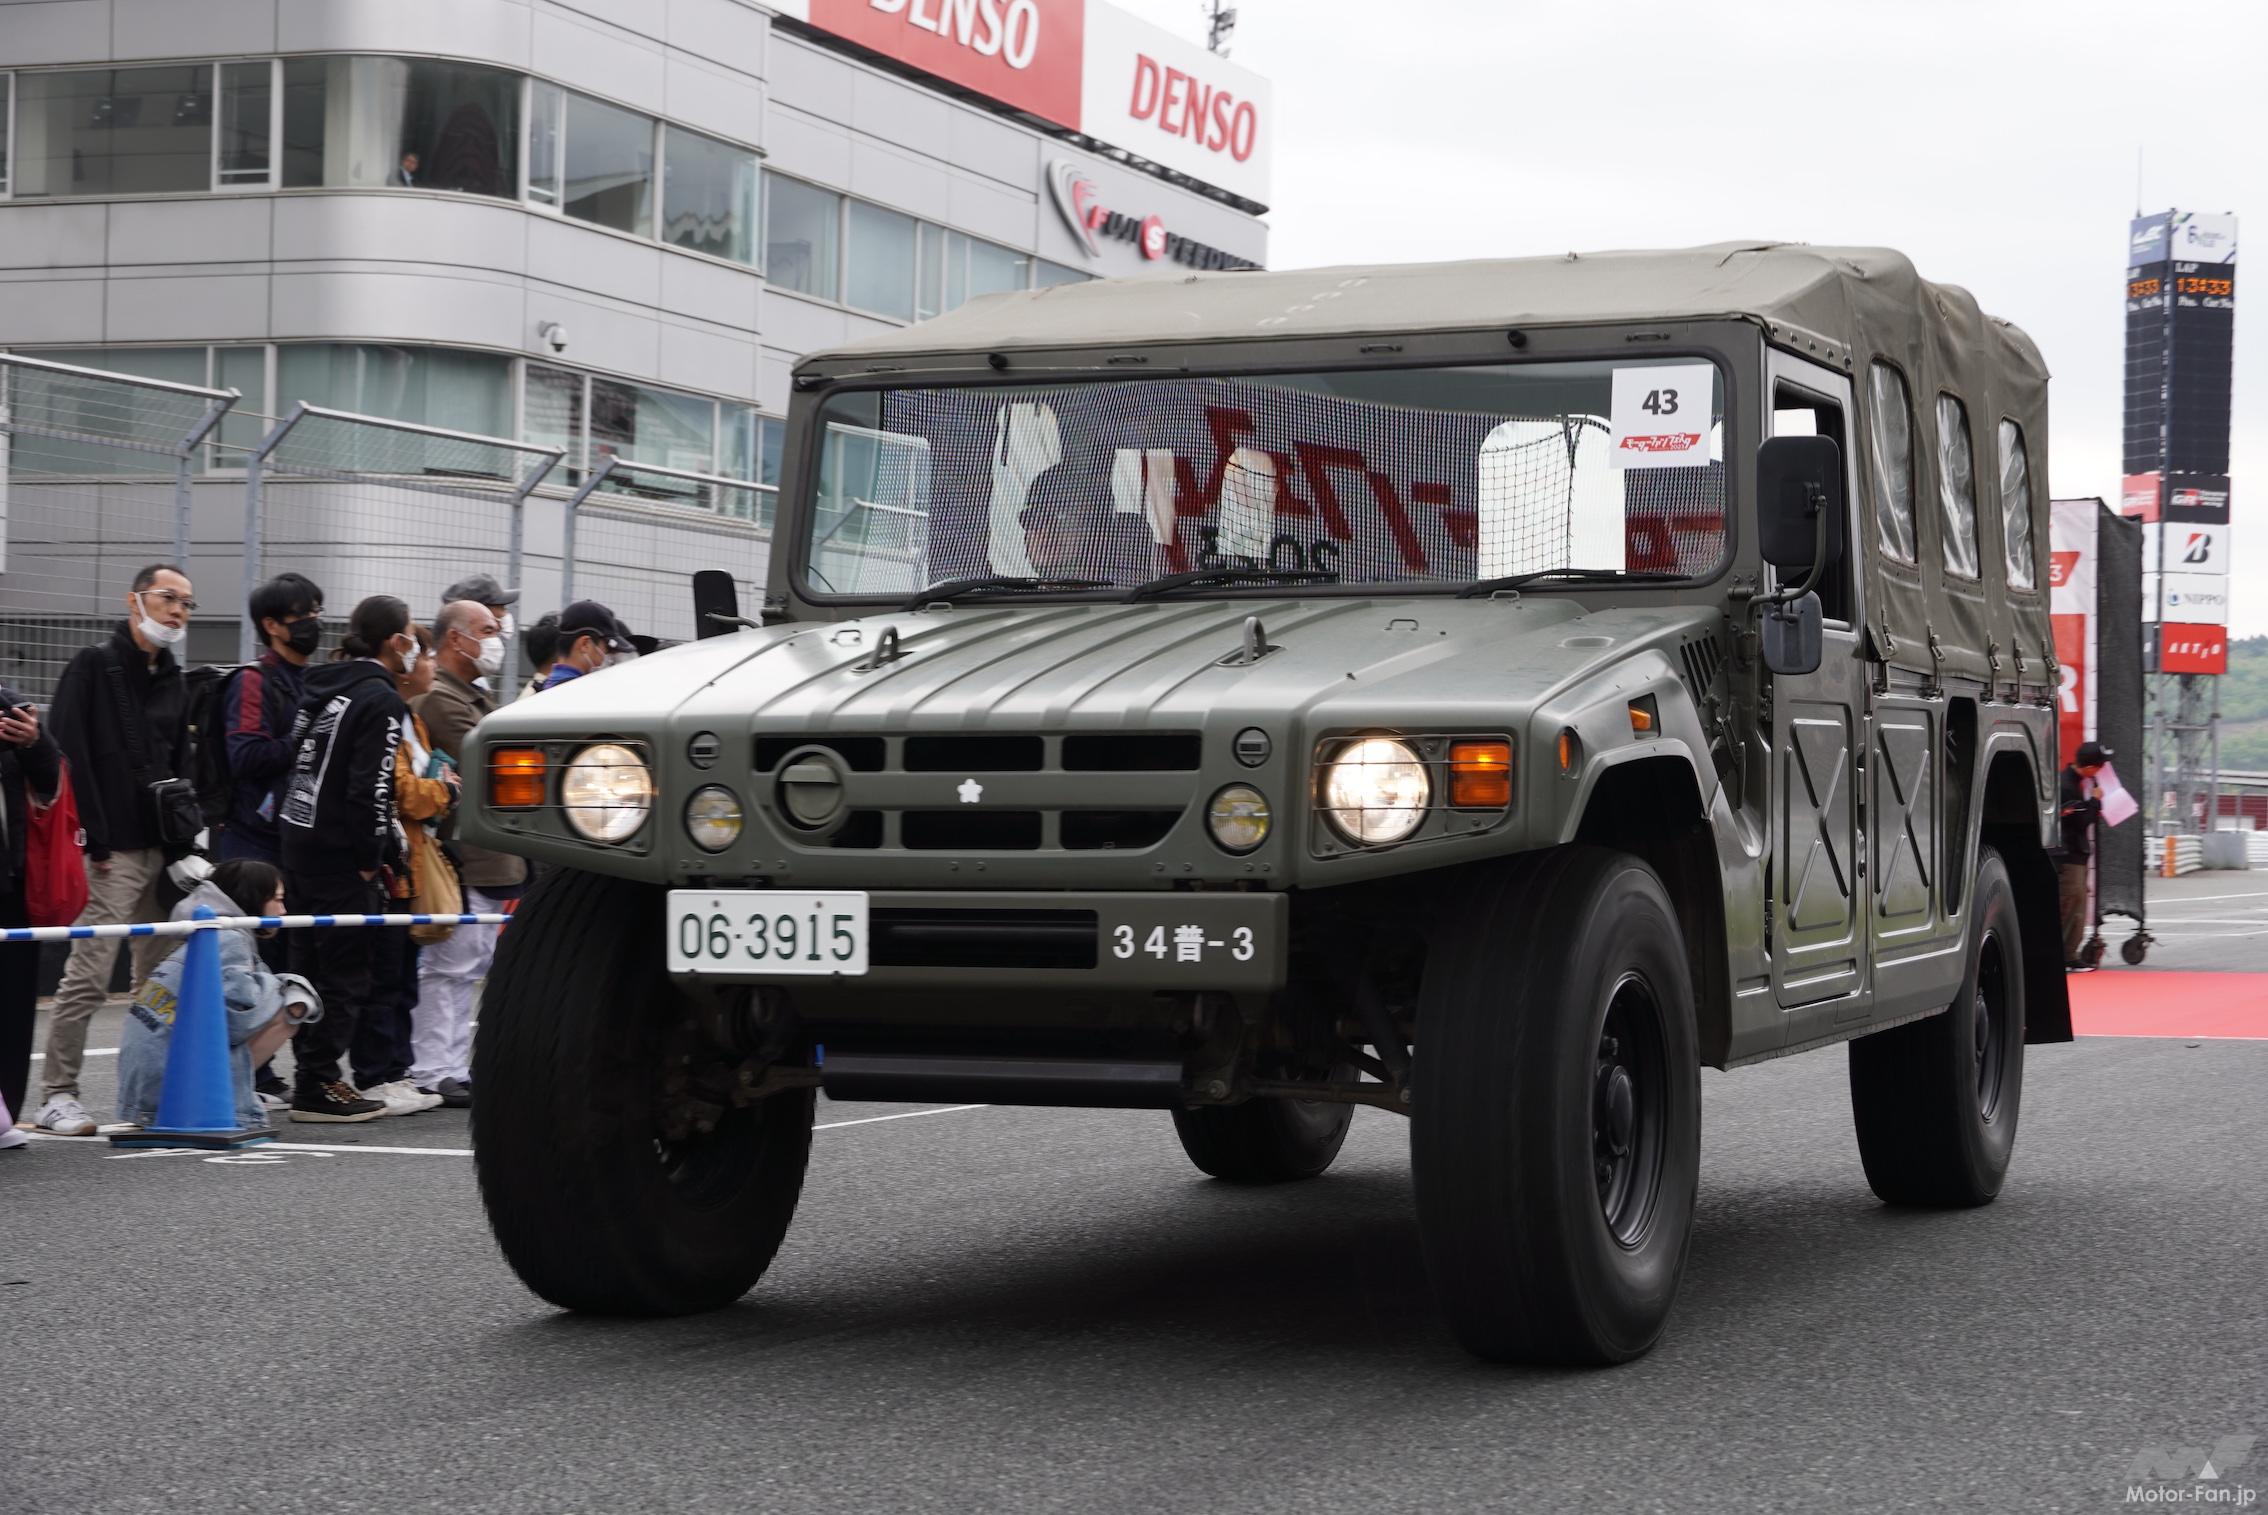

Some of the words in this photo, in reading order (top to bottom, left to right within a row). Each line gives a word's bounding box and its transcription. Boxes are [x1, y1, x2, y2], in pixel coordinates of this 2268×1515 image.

[869, 0, 1040, 70] NSO
[1129, 53, 1257, 163] DENSO
[1088, 205, 1142, 243] FUJI
[1142, 214, 1265, 271] SPEEDW
[1642, 389, 1679, 415] 43
